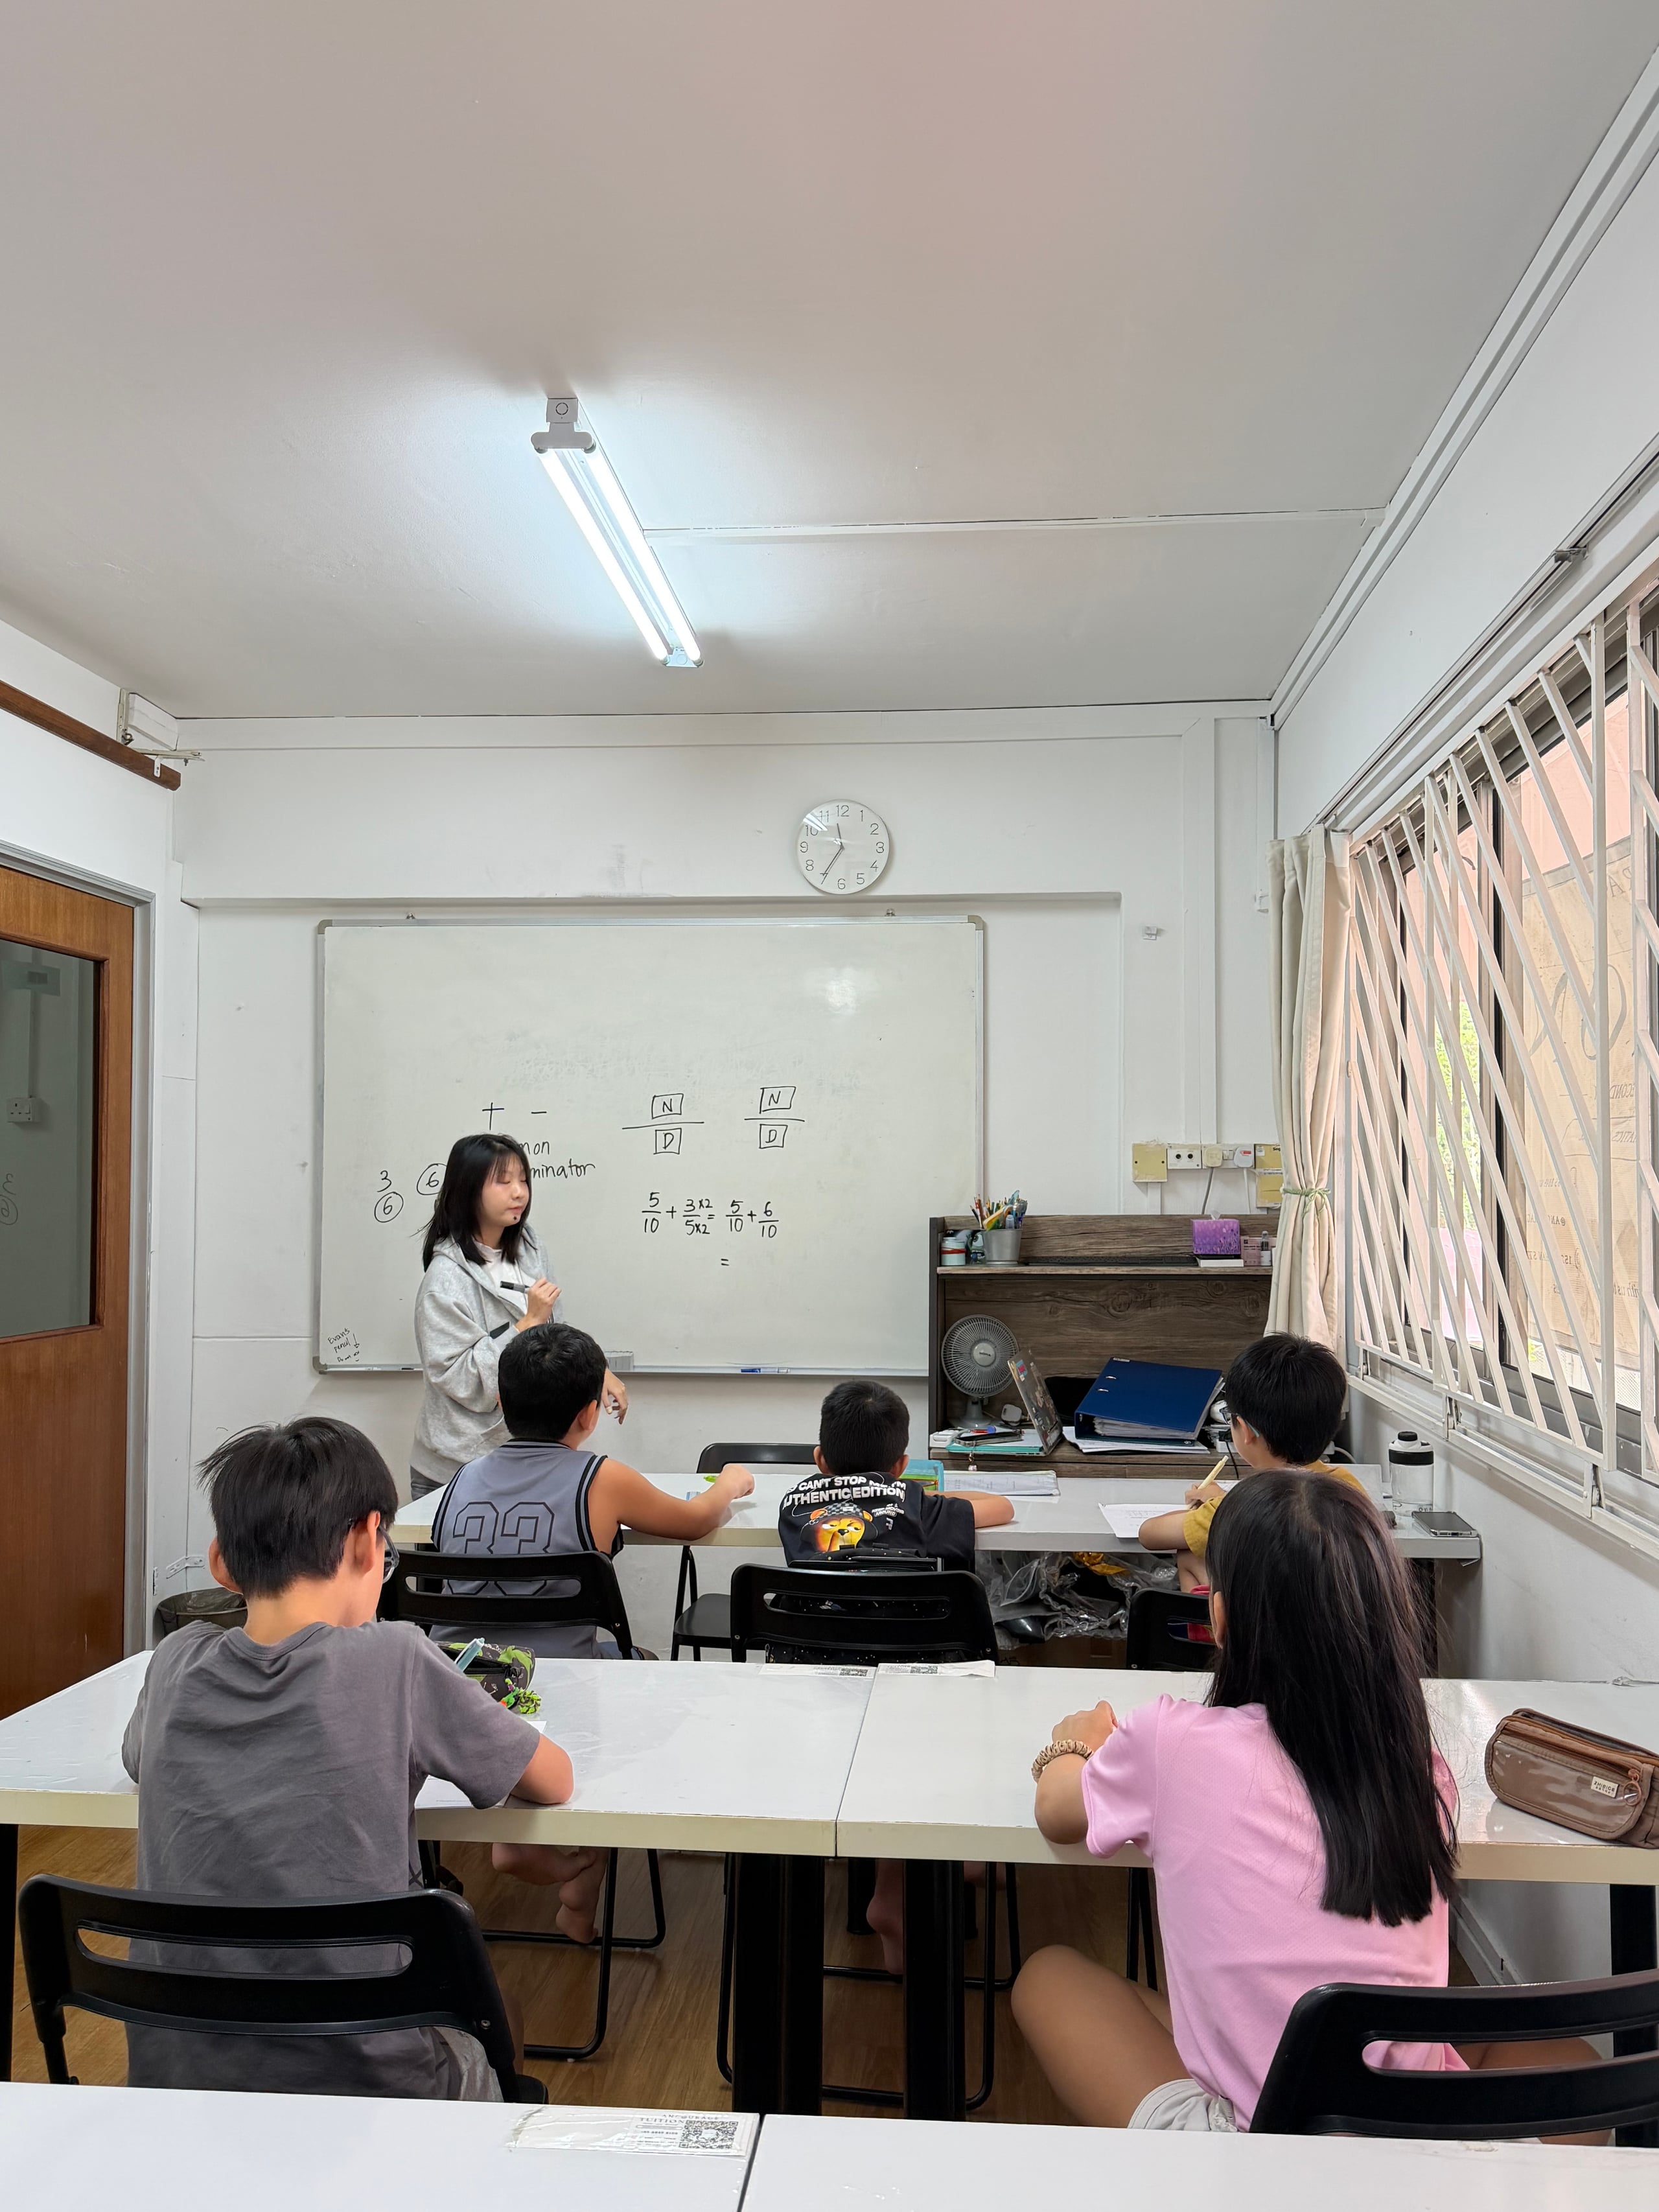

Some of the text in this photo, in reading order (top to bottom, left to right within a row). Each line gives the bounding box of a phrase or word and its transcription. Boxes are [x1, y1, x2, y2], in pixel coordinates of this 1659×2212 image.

[819, 810, 830, 822] 11
[836, 804, 850, 817] 12
[860, 809, 863, 822] 1
[870, 822, 879, 835] 2
[800, 841, 809, 853] 9
[876, 841, 885, 854] 3
[806, 859, 815, 871] 8
[870, 860, 879, 872] 4
[837, 878, 846, 890] 6
[856, 872, 865, 885] 5
[769, 1090, 781, 1106] N
[662, 1098, 673, 1113] N
[662, 1132, 674, 1150] D
[765, 1130, 778, 1143] D
[377, 1170, 392, 1193] 3
[426, 1171, 439, 1187] 6
[383, 1196, 393, 1215] 6
[649, 1192, 660, 1207] 5
[730, 1200, 744, 1214] 5
[763, 1201, 772, 1217] 6
[644, 1218, 659, 1233] 10
[730, 1218, 743, 1232] 10
[761, 1224, 777, 1239] 10
[798, 1478, 831, 1491] CAN'T
[834, 1476, 867, 1486] STOP
